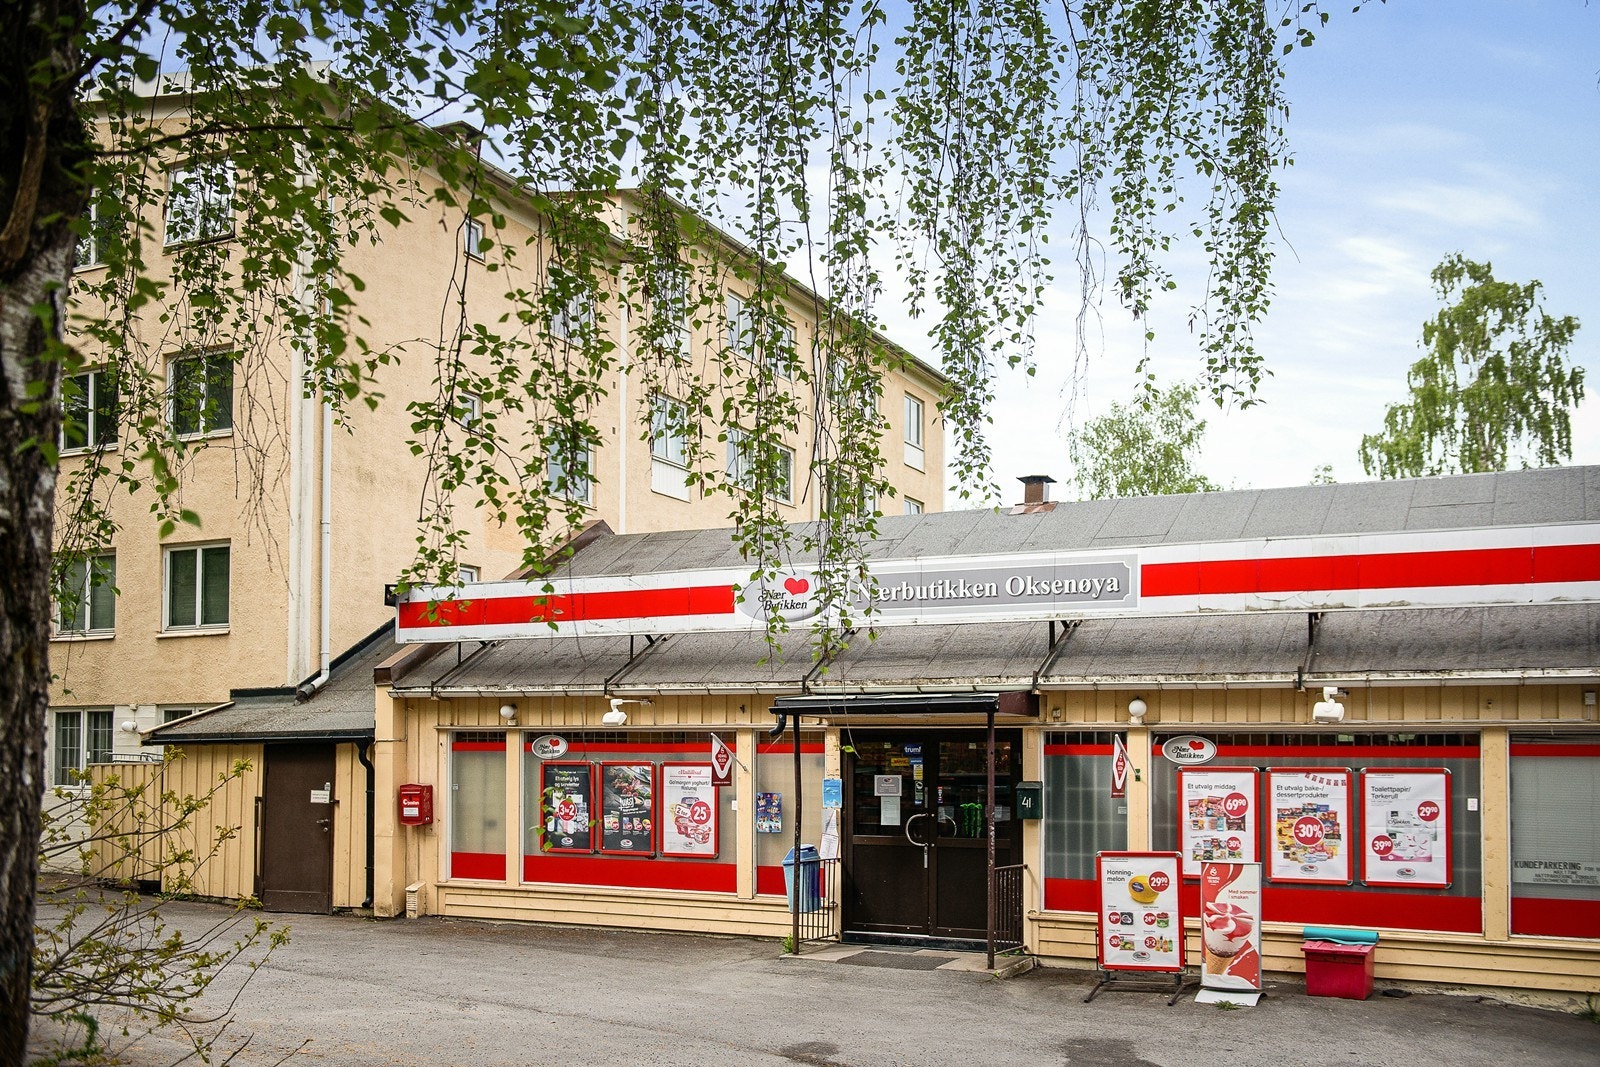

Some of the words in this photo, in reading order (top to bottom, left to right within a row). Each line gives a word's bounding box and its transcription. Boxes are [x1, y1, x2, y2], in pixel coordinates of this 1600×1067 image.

[856, 574, 998, 603] Nærbutikken
[1005, 573, 1120, 599] Oksenøya
[758, 589, 787, 602] Nær
[763, 600, 808, 611] Butikken
[1171, 746, 1190, 754] Nær
[1175, 750, 1204, 759] Butikken
[1195, 783, 1213, 791] utvalg
[1214, 783, 1237, 791] middag
[1371, 785, 1412, 793] Toalettpapir/
[1021, 796, 1032, 808] 41
[693, 806, 707, 820] 25
[1295, 823, 1323, 838] -30%
[1514, 860, 1582, 871] KUNDEPARKERING
